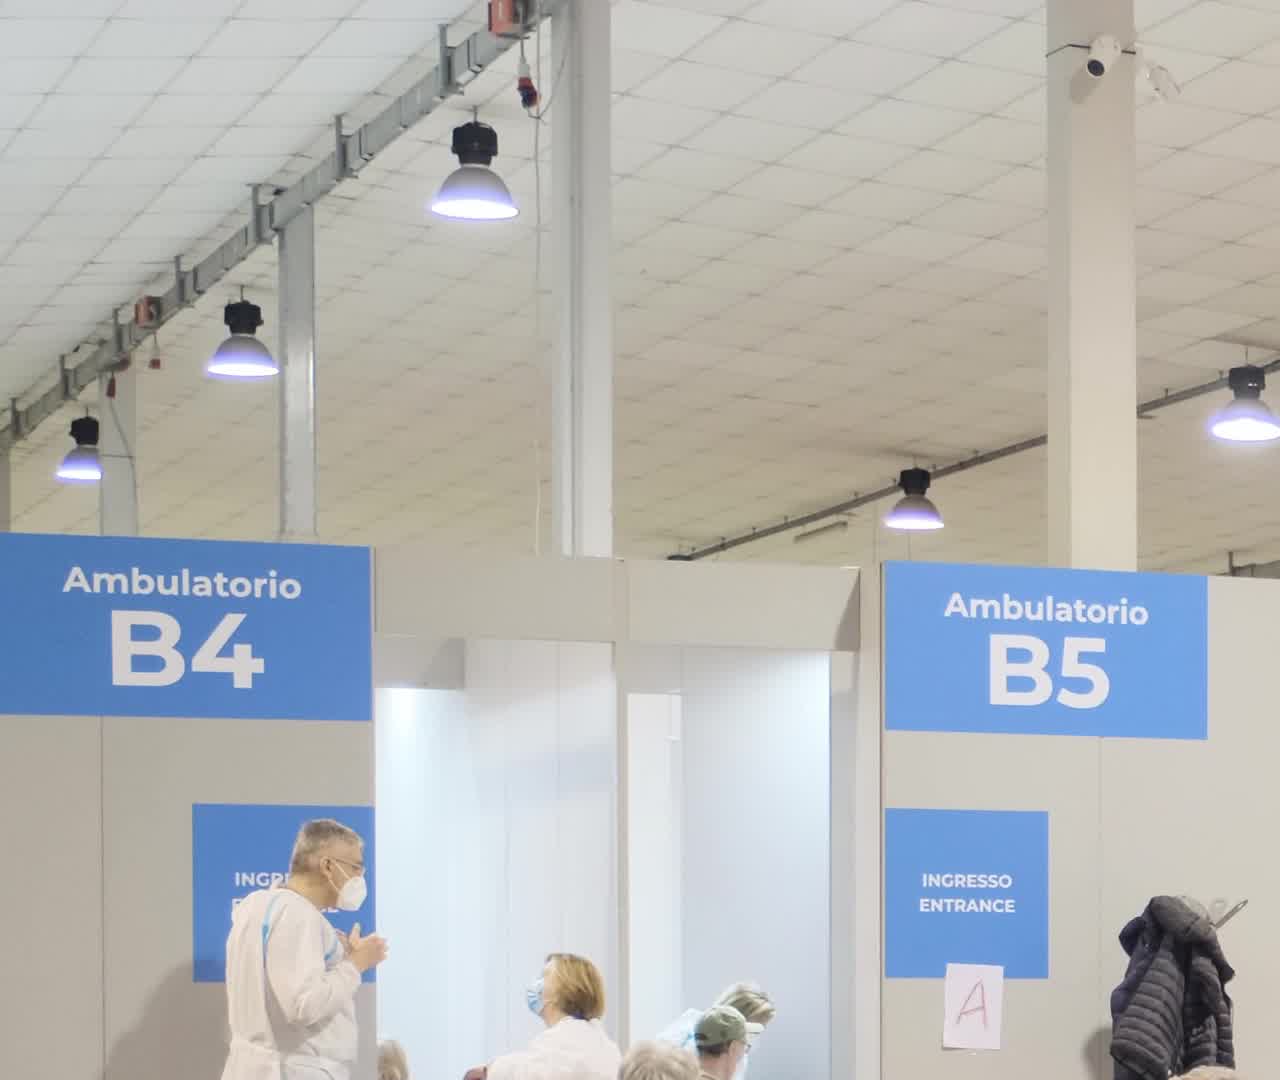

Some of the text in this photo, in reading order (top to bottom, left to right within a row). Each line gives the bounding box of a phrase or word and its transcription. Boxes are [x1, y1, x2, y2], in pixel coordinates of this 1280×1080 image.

[62, 566, 302, 600] Ambulatorio
[944, 592, 1149, 625] Ambulatorio
[111, 610, 265, 689] B4
[989, 634, 1110, 709] B5
[235, 872, 289, 888] INGR
[922, 873, 1013, 889] INGRESSO
[919, 898, 1016, 913] ENTRANCE
[956, 978, 989, 1031] A
